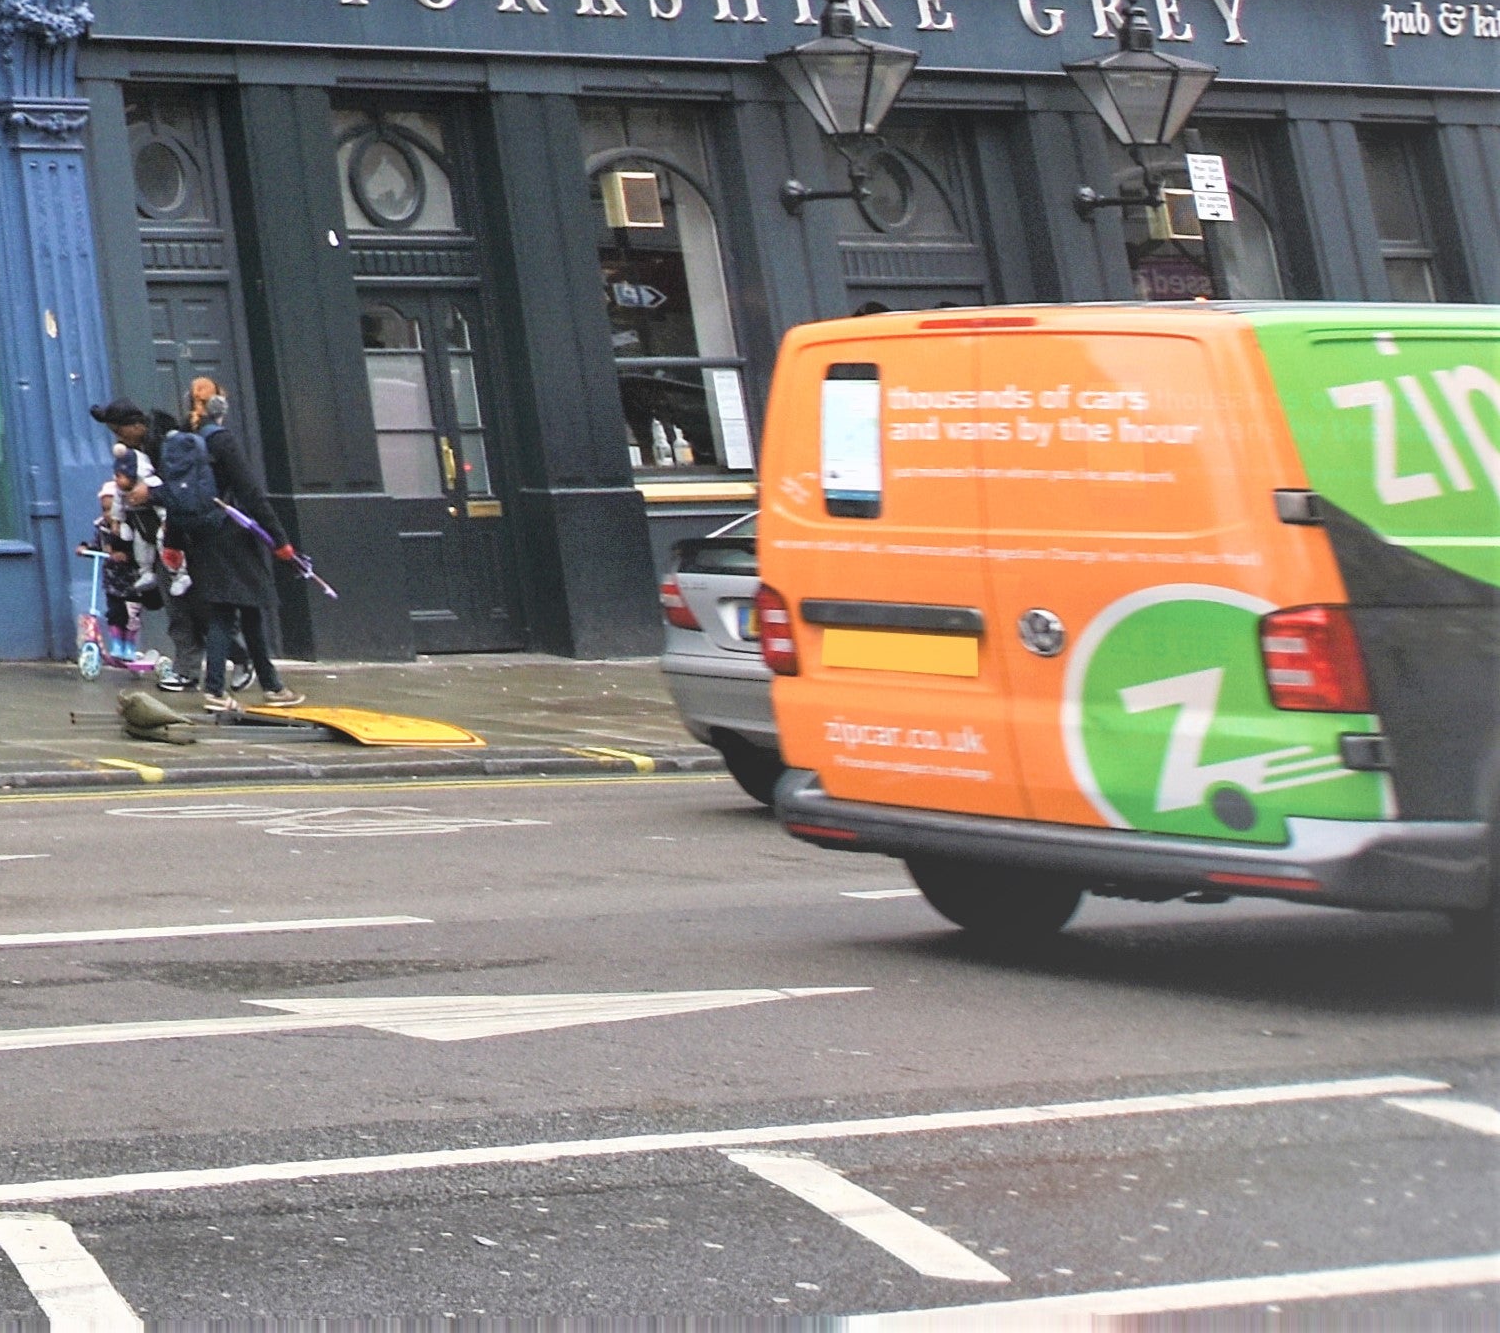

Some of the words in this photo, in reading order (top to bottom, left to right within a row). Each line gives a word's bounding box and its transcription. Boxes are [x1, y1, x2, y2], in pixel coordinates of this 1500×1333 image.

[1381, 1, 1431, 46] pub
[1439, 2, 1467, 36] &
[887, 385, 1034, 411] thousands
[1040, 383, 1072, 410] of
[1077, 388, 1150, 412] cars
[888, 417, 940, 442] and
[942, 419, 1012, 441] vans
[1017, 416, 1053, 447] by
[1058, 417, 1112, 443] the
[1119, 416, 1203, 445] hour
